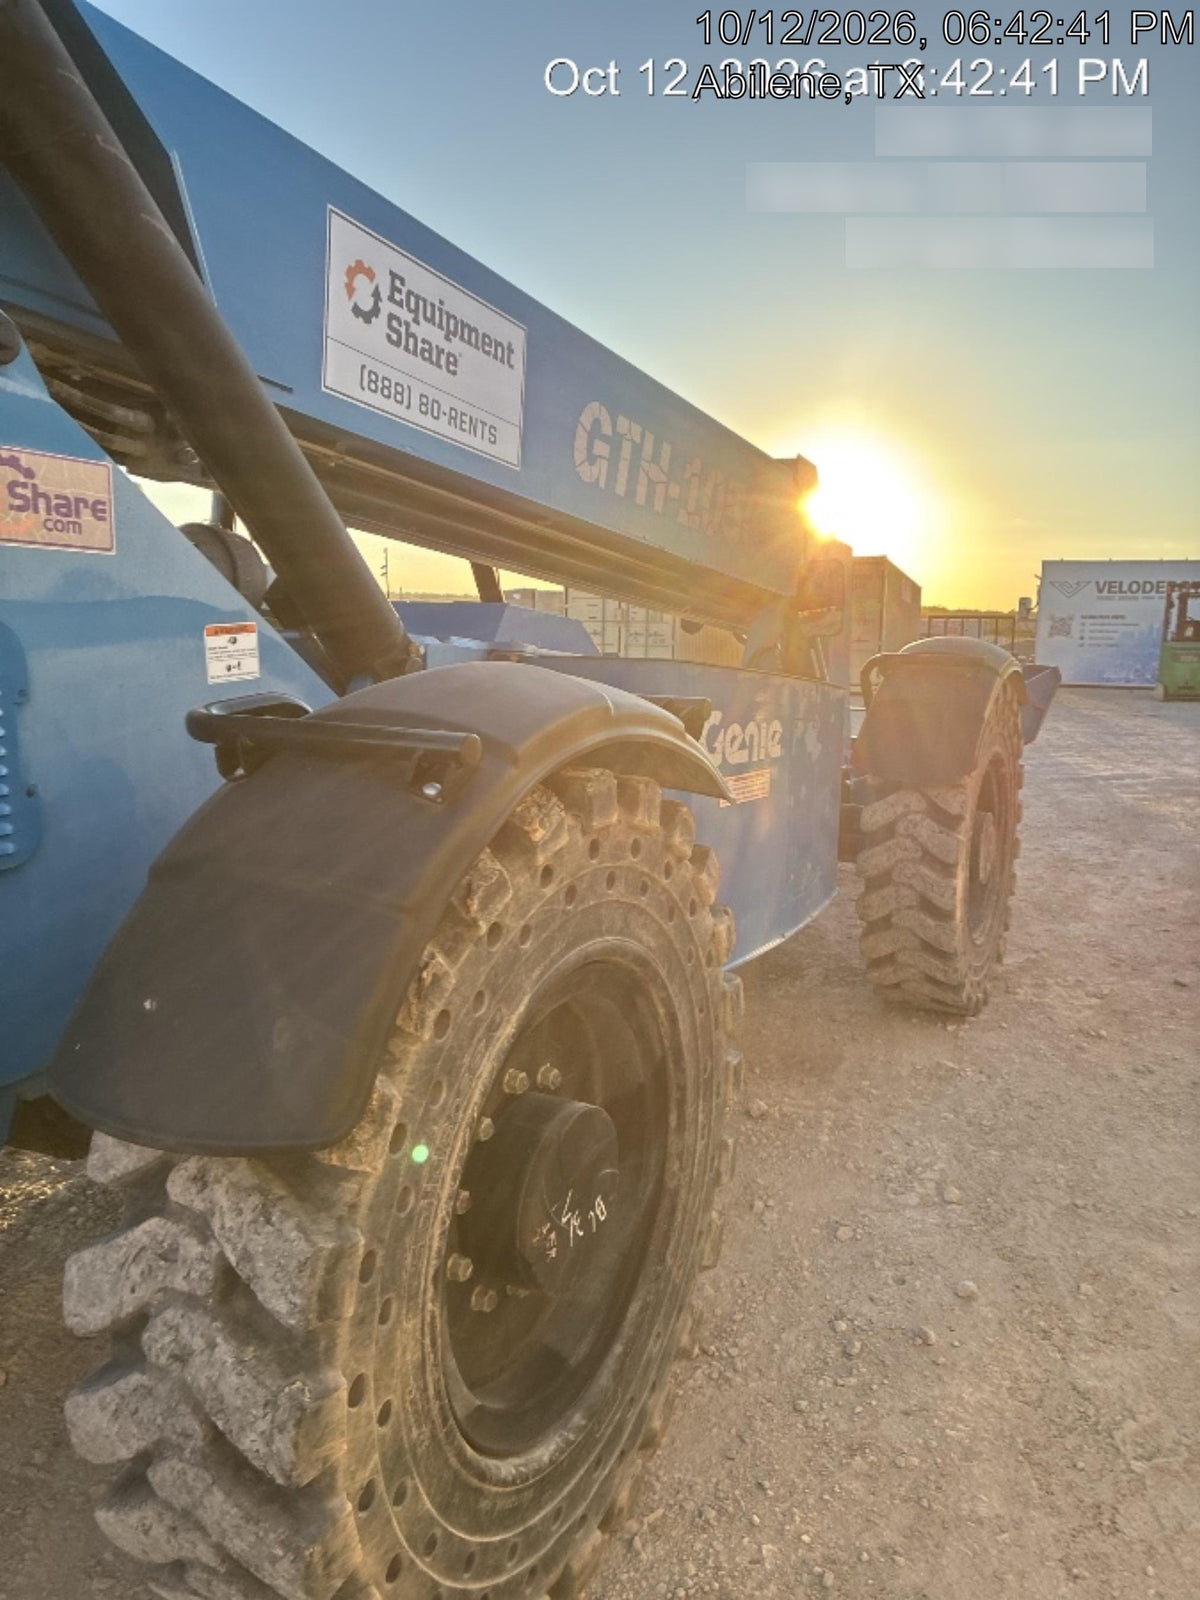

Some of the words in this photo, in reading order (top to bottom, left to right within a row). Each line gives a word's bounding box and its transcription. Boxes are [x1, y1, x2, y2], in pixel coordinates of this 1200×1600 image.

[385, 312, 459, 377] Share
[387, 269, 515, 371] Equipment
[359, 363, 412, 411] (888)
[418, 393, 498, 446] 80-RENTS
[6, 479, 108, 522] Share
[42, 518, 83, 535] com
[1095, 580, 1168, 595] VELODE
[698, 710, 784, 768] Genie
